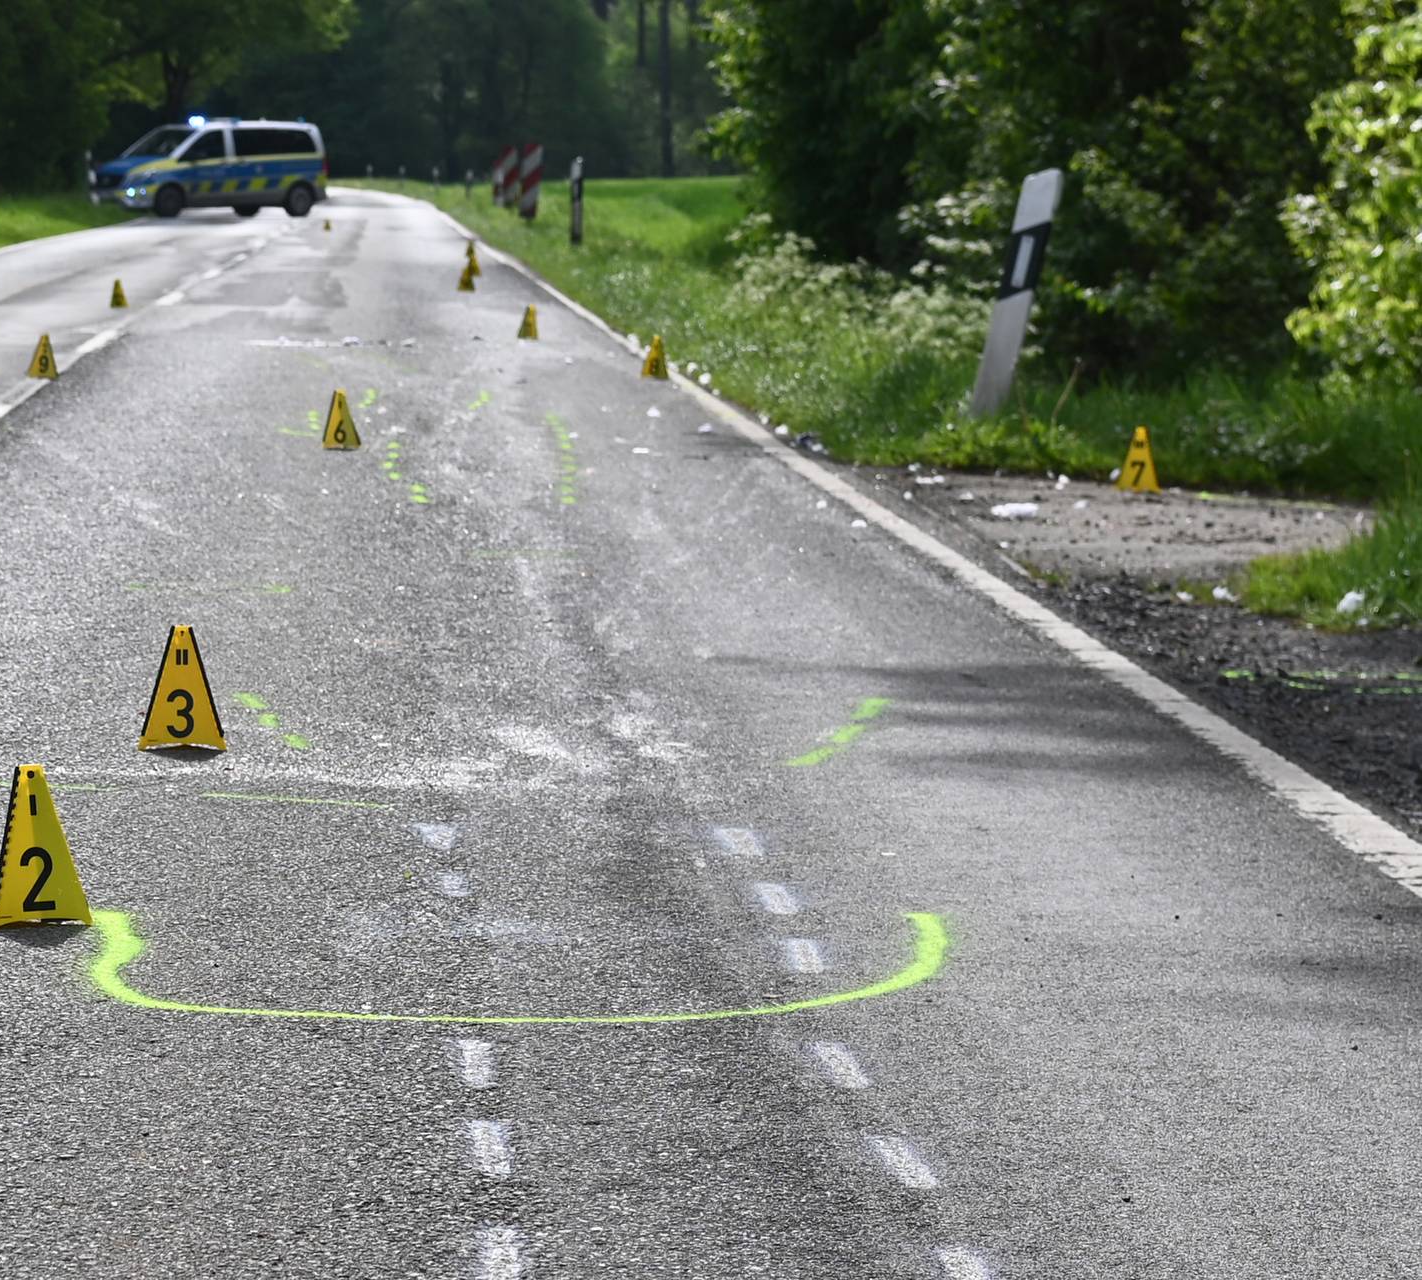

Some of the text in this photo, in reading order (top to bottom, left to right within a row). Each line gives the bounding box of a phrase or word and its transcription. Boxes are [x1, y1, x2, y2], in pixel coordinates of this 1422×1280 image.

[39, 355, 49, 373] 9
[334, 420, 347, 443] 6
[1131, 462, 1145, 486] 7
[167, 689, 194, 739] 3
[20, 846, 56, 912] 2
